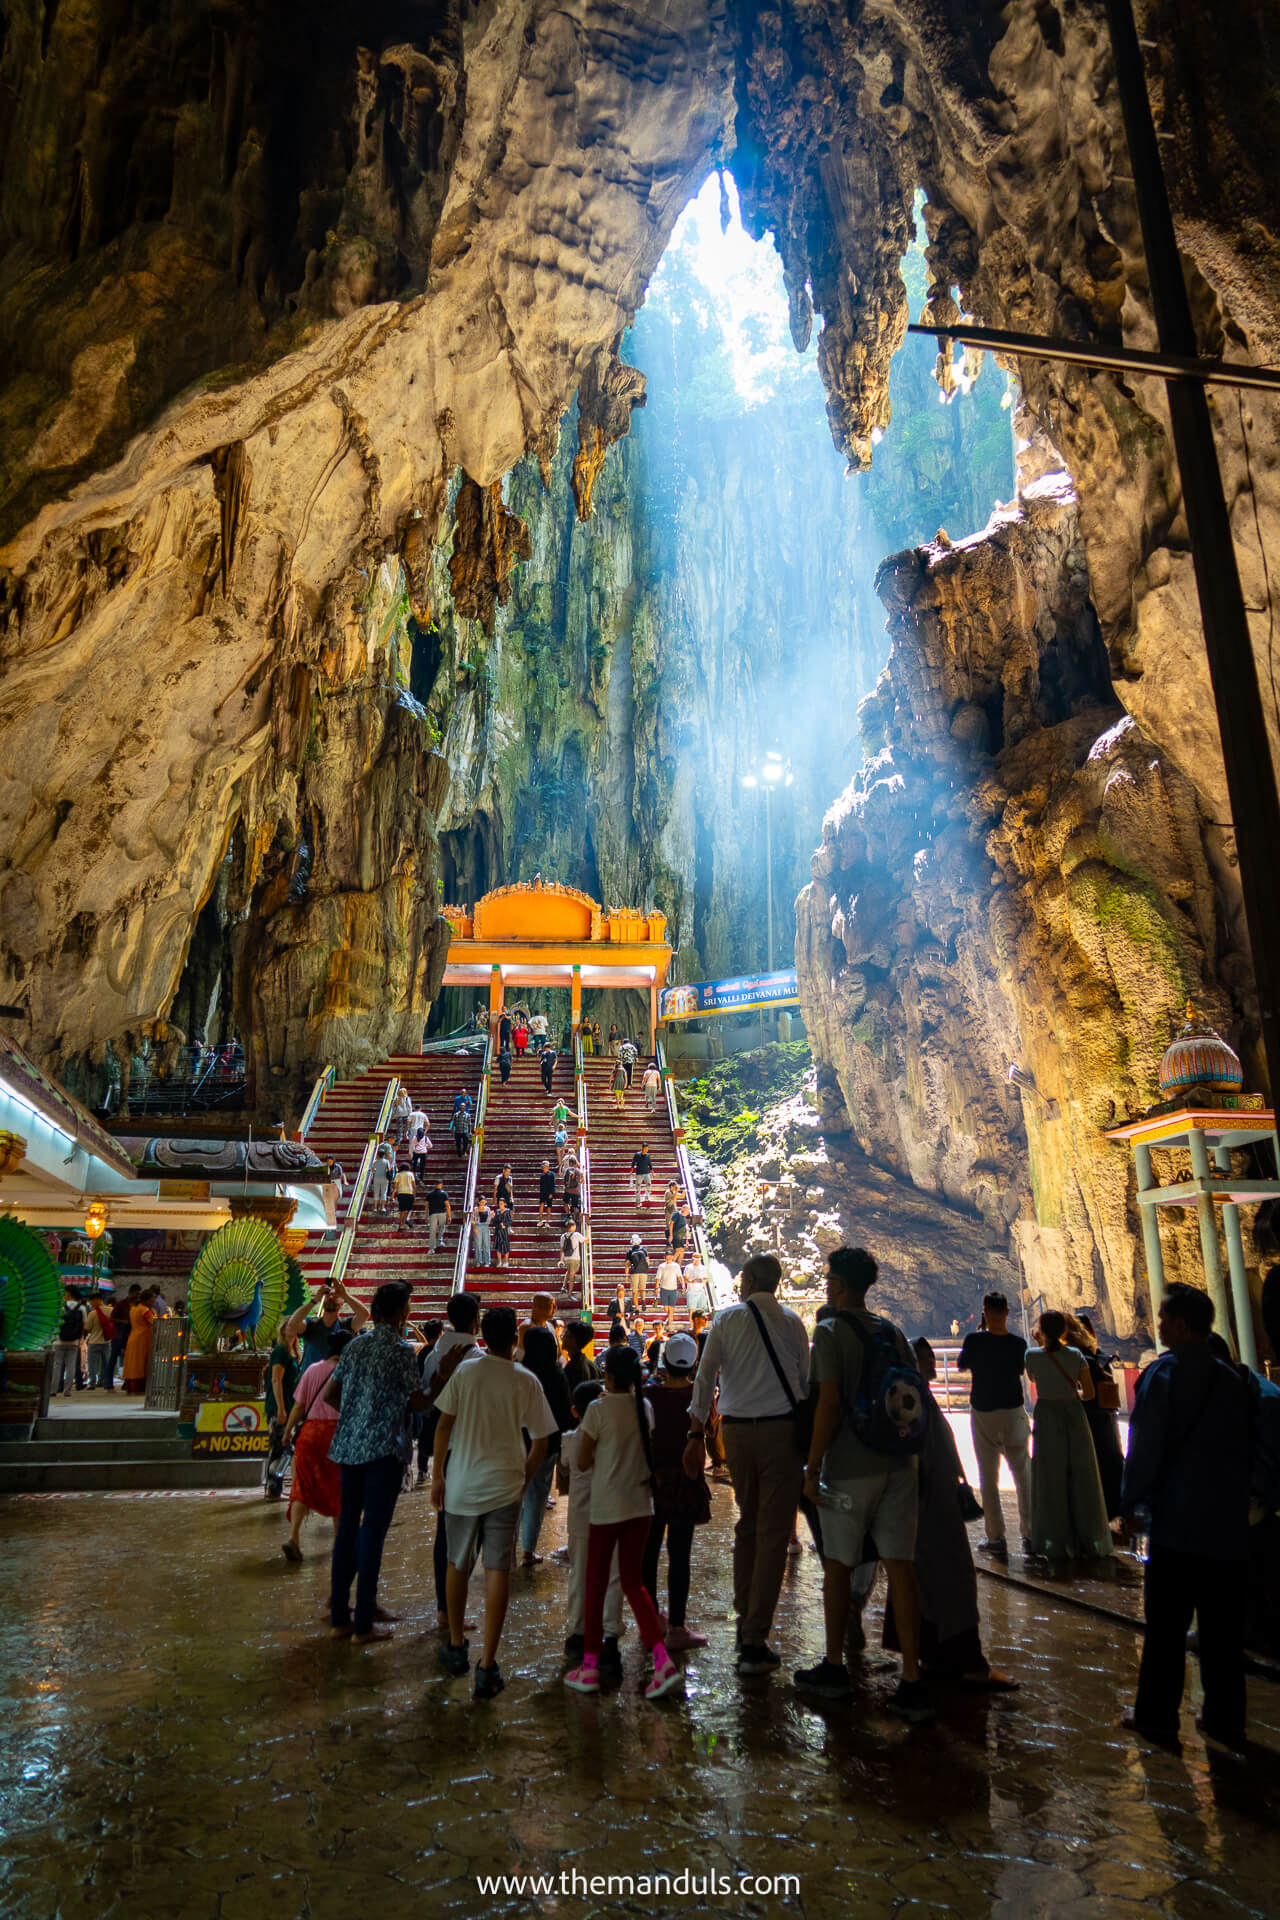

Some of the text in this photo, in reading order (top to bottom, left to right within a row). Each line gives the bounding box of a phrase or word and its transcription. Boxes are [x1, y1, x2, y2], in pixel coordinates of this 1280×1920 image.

[703, 998, 716, 1006] SRI
[717, 994, 740, 1005] VALLI
[741, 990, 781, 1001] DEIVANAI
[209, 1436, 230, 1452] NO
